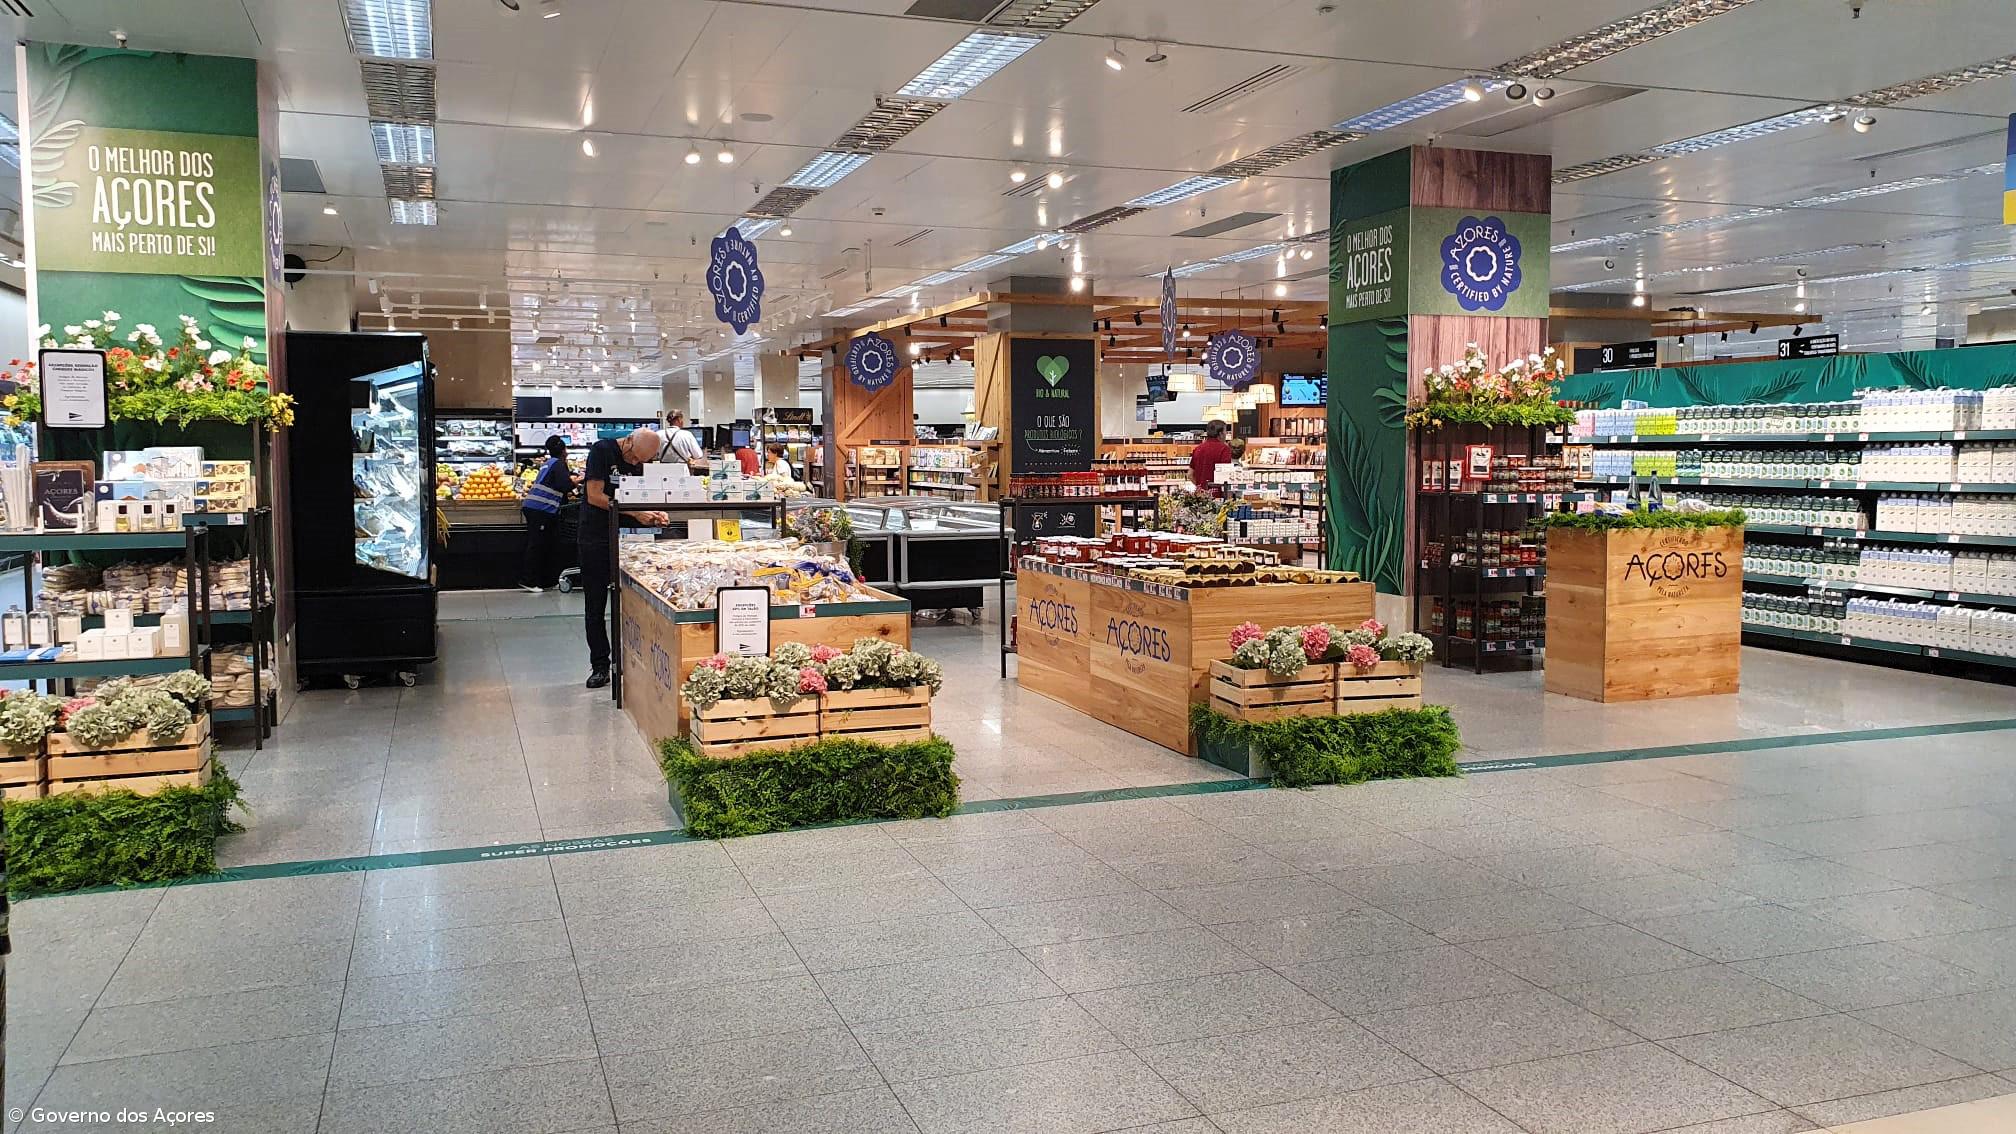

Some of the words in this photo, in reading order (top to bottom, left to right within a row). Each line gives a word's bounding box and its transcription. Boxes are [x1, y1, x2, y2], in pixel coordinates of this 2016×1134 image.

[88, 145, 100, 172] O
[105, 146, 175, 176] MELHOR
[182, 151, 214, 177] DOS
[92, 177, 216, 231] AÇORES
[92, 233, 126, 254] MAIS
[129, 234, 173, 255] PERTO
[177, 235, 195, 256] DE
[198, 236, 216, 257] SI!
[1346, 234, 1352, 251] O
[1352, 228, 1378, 250] MELHOR
[1379, 225, 1393, 245] DOS
[1450, 225, 1499, 263] AZORES
[731, 239, 753, 266] NATURE
[712, 246, 733, 315] AZORES
[750, 269, 759, 281] BY
[1346, 247, 1393, 291] AÇORES
[1450, 271, 1490, 302] CERTIFIED
[1491, 285, 1503, 299] BY
[1501, 245, 1515, 287] NATURE
[737, 287, 760, 323] CERTIFIED
[1346, 293, 1358, 309] MAIS
[1358, 291, 1375, 307] PERTO
[1375, 290, 1384, 303] DE
[866, 337, 895, 368] AZORES
[1228, 334, 1255, 363] AZORES
[1602, 347, 1614, 363] 30
[1779, 342, 1790, 357] 31
[867, 373, 889, 386] NATURE
[1226, 368, 1250, 381] NATURE
[556, 404, 603, 415] peixes
[1036, 415, 1042, 428] O
[1044, 415, 1056, 429] QUE
[1058, 413, 1070, 428] SÃO
[44, 488, 78, 497] AÇORES
[1624, 551, 1728, 587] AÇORES
[1029, 597, 1079, 635] AÇORES
[1106, 616, 1171, 662] AÇORES
[480, 848, 537, 858] SUPER
[542, 838, 652, 853] PROMOÇÕES
